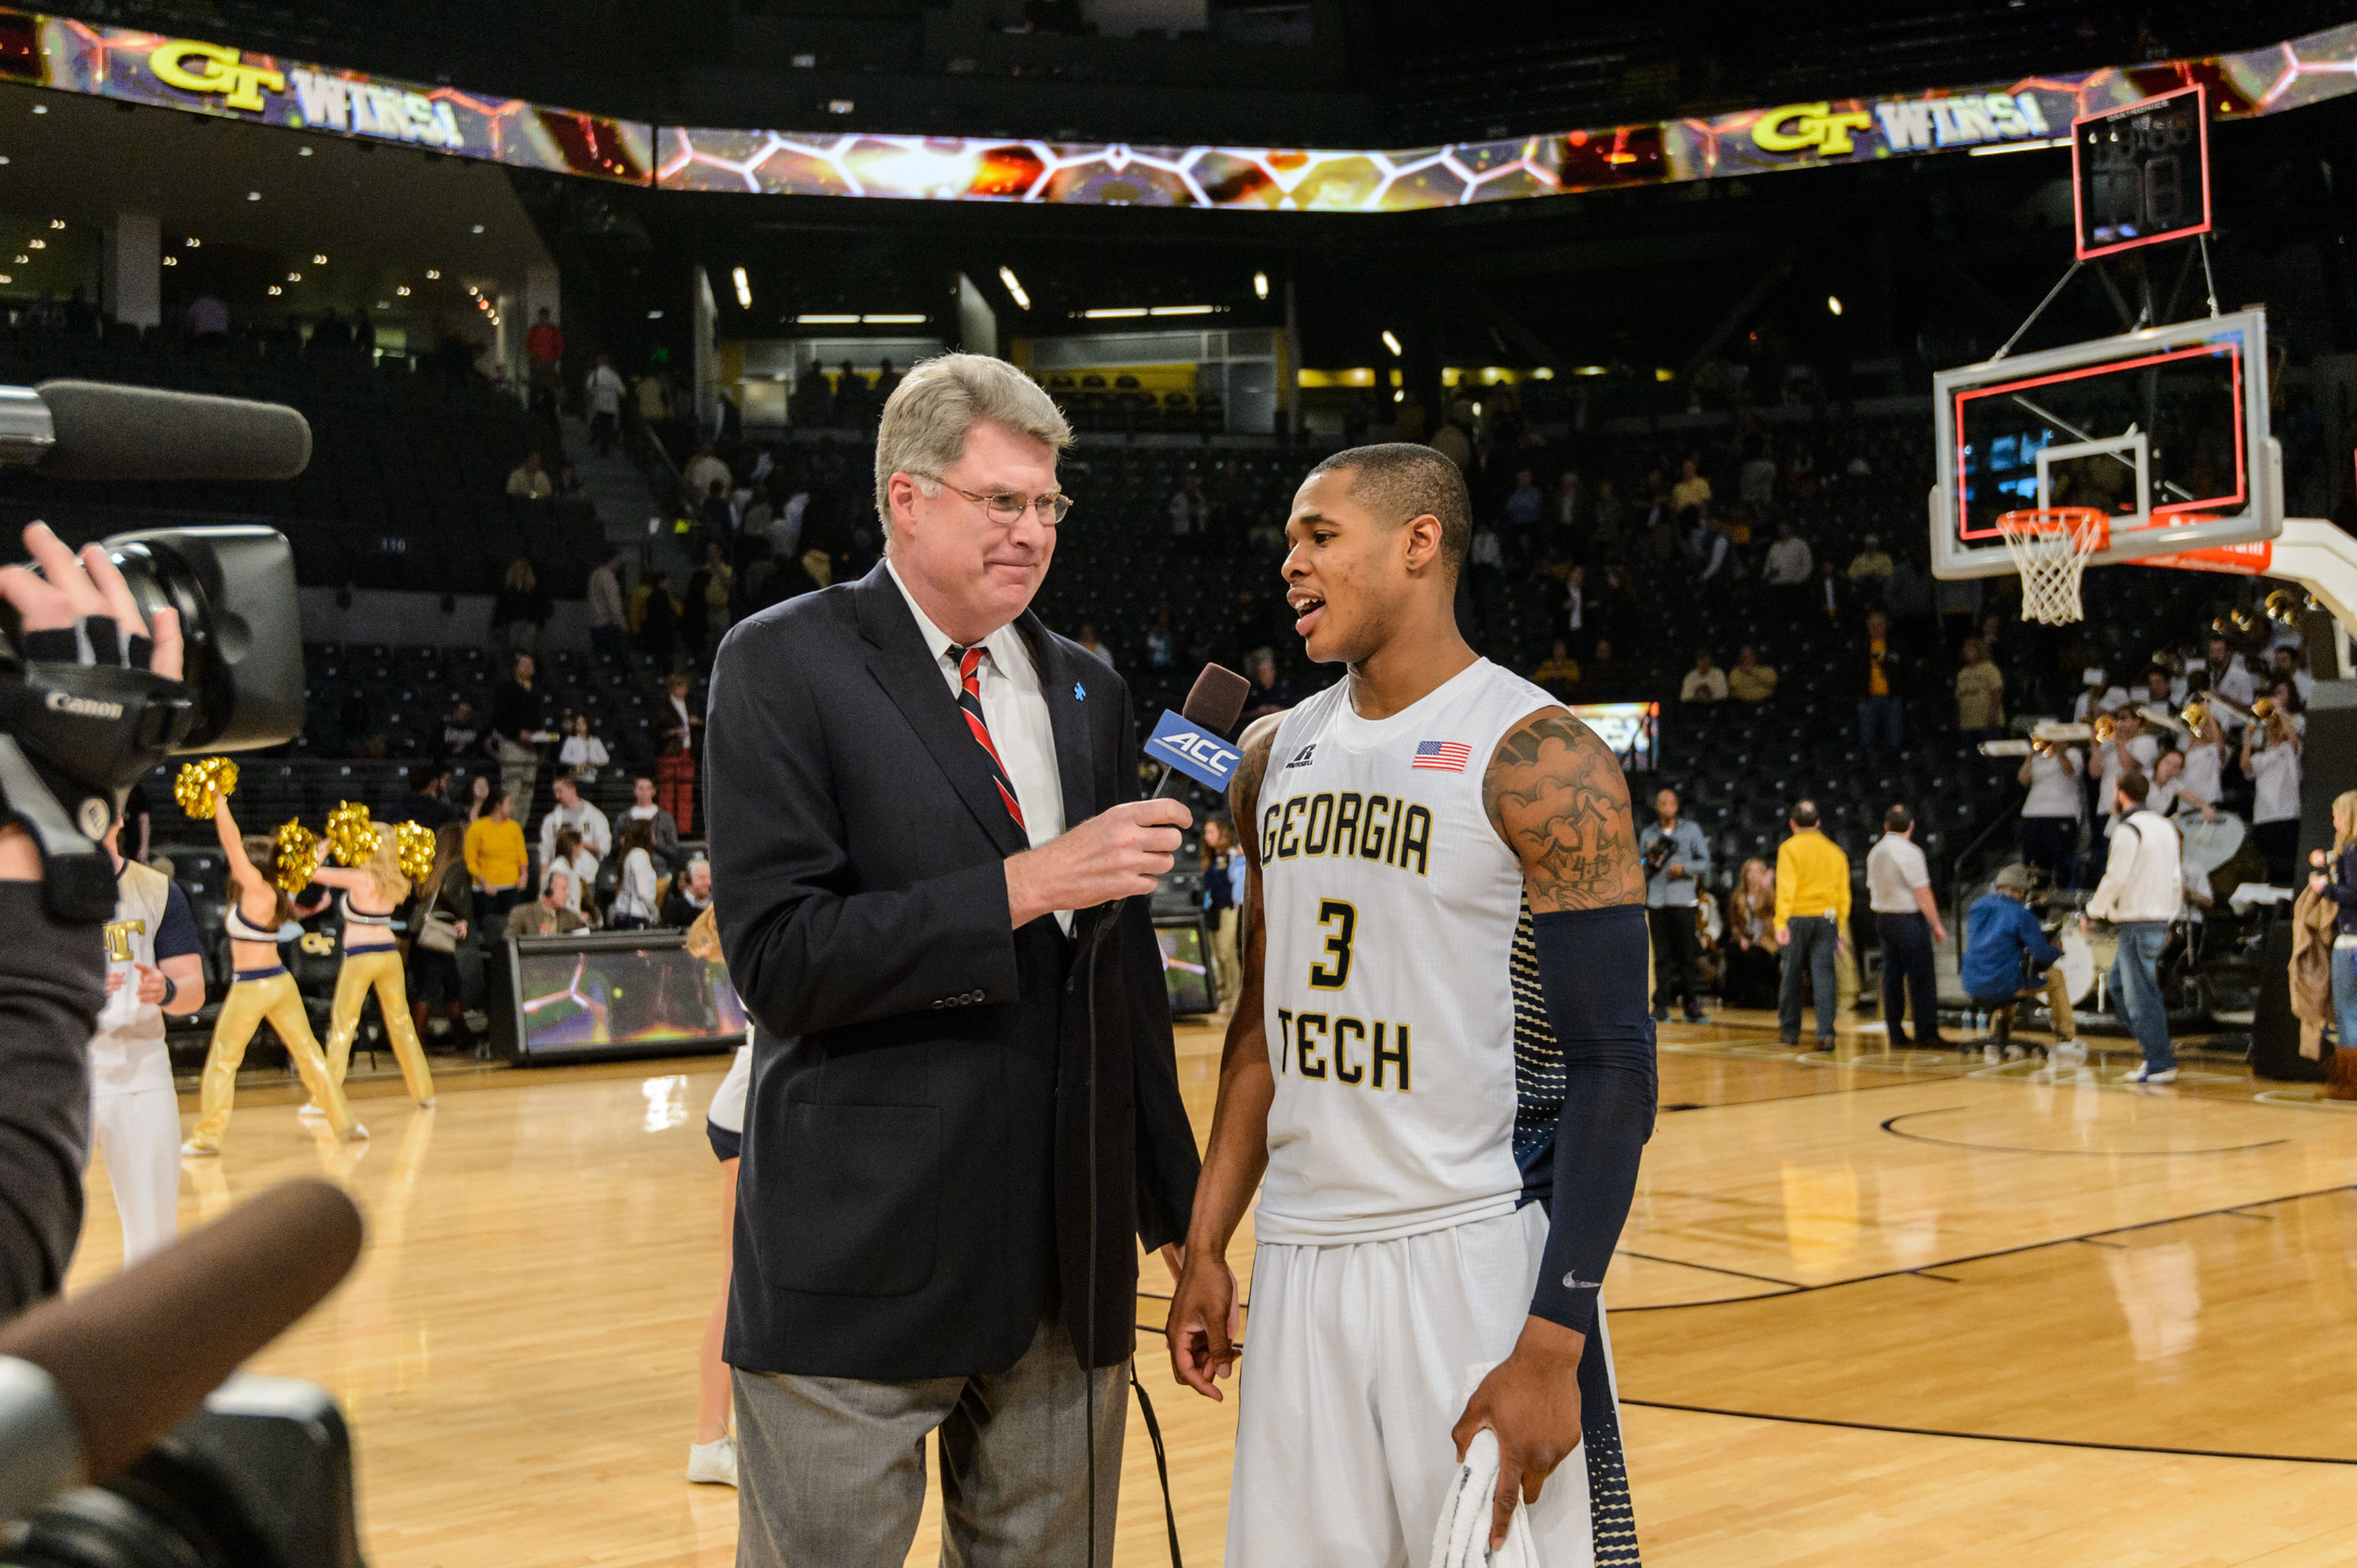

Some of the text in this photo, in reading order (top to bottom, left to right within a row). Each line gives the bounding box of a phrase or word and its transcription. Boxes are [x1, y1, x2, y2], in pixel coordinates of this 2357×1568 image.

[148, 39, 465, 148] GT WINS!
[1751, 100, 1871, 157] GT
[1876, 92, 2051, 153] WINS!
[44, 692, 124, 720] Canon
[1162, 732, 1241, 773] ACC
[1261, 790, 1434, 878] GEORGIA
[1309, 898, 1358, 991] 3
[1277, 1007, 1411, 1094] TECH
